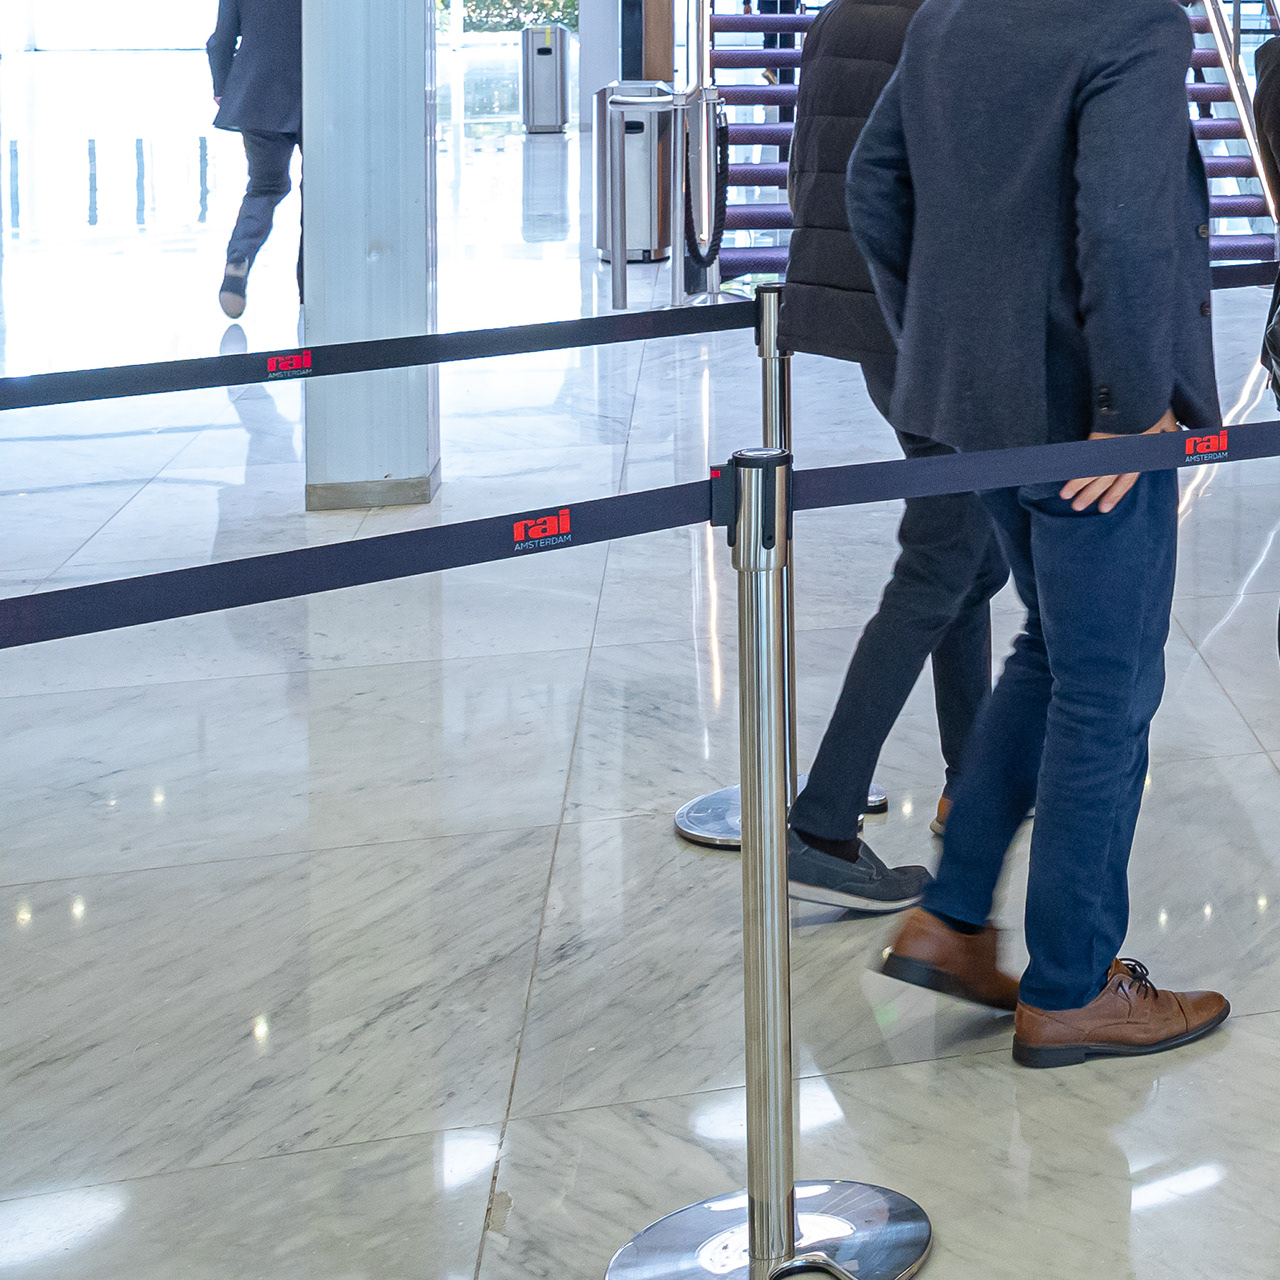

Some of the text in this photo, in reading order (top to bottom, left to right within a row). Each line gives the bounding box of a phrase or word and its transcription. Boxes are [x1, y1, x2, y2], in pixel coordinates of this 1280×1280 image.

[267, 350, 312, 372] rai
[268, 368, 312, 379] AMSTERDAM
[1185, 430, 1228, 455] rai
[1185, 451, 1228, 462] AMSTERDAM
[513, 508, 571, 542] rai
[514, 534, 572, 551] AMSTERDAM
